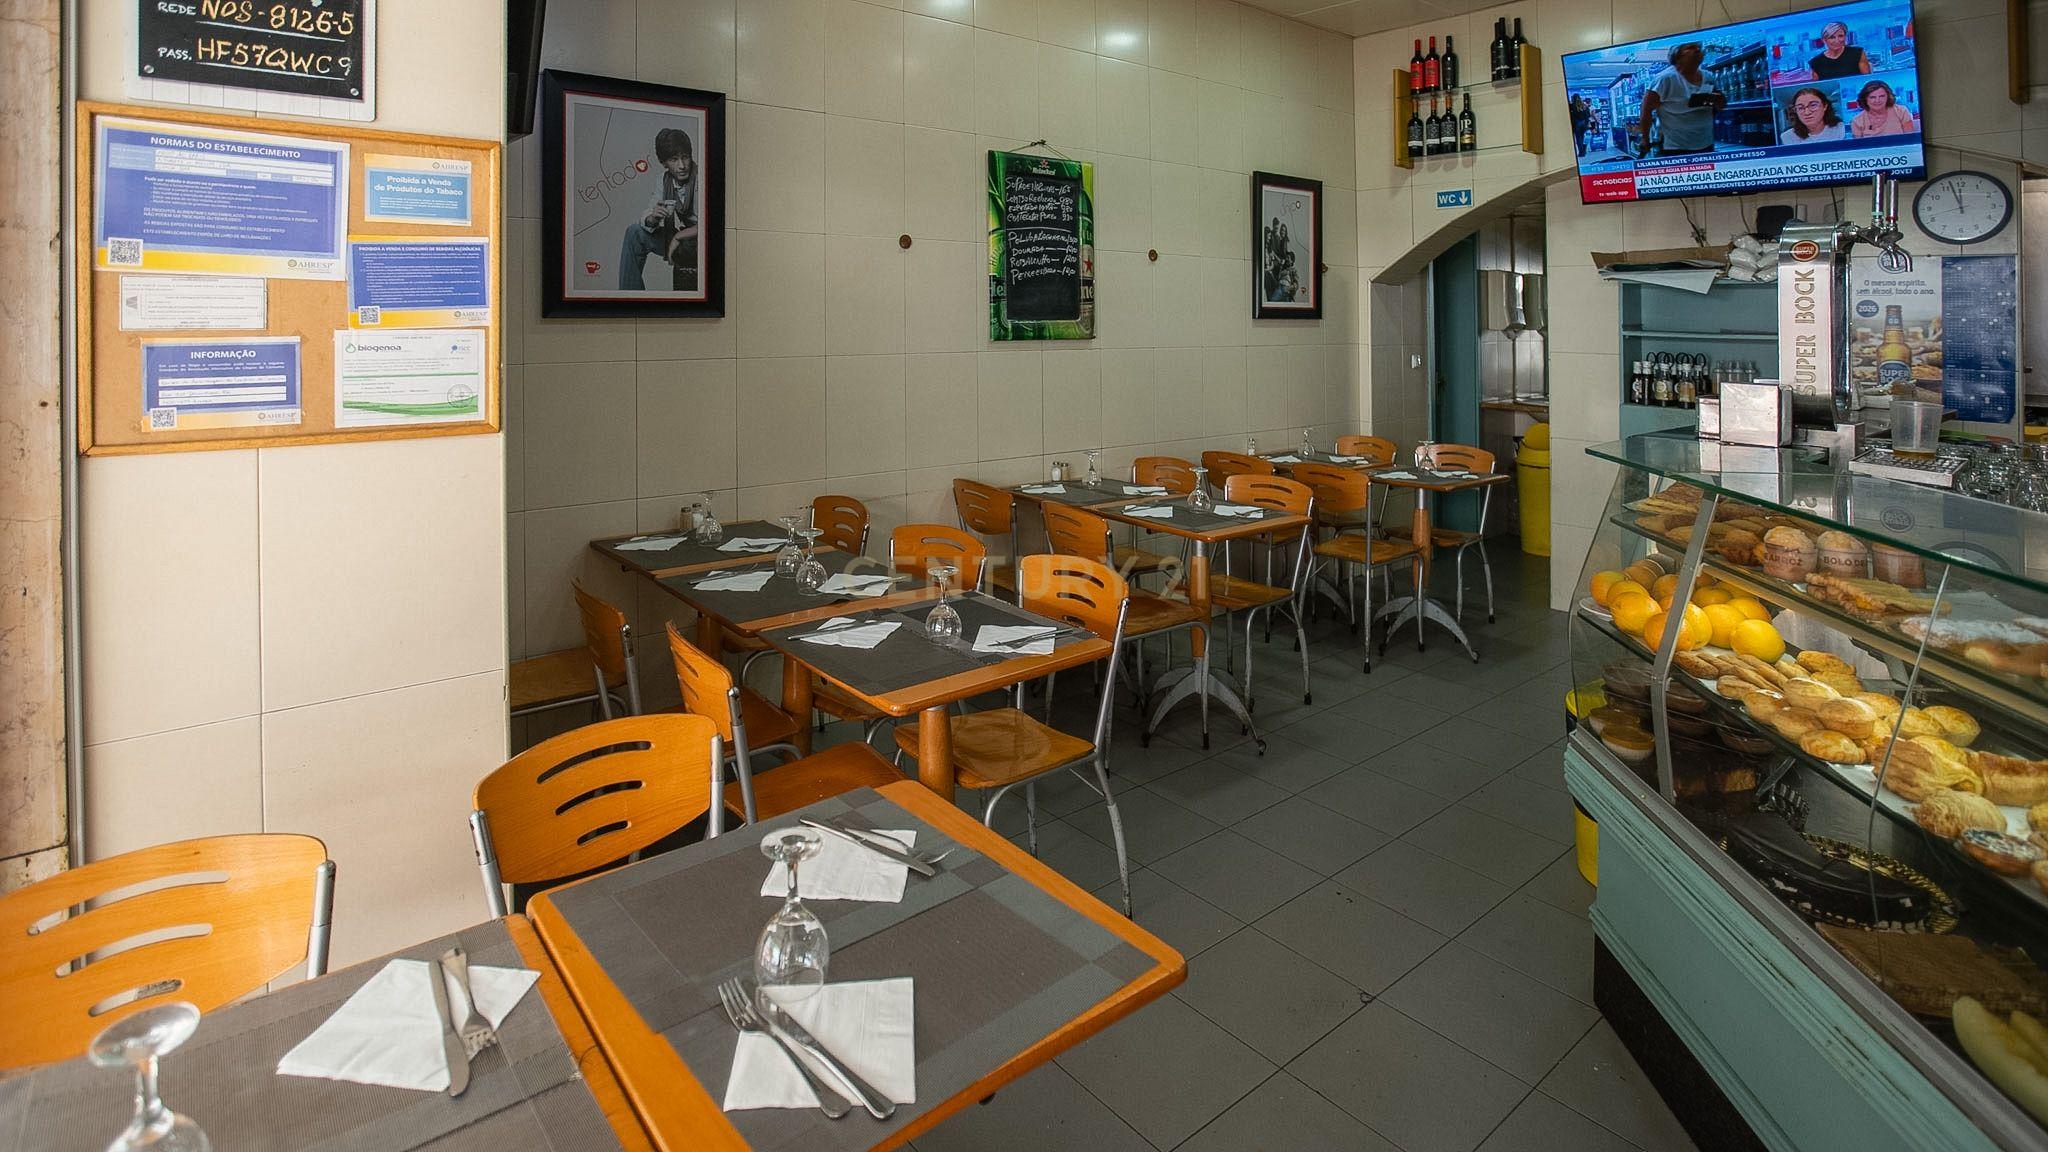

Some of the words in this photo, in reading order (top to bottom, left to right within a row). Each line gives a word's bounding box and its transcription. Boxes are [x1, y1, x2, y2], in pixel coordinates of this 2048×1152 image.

[158, 2, 196, 15] REDE
[158, 47, 192, 61] PASS.
[1460, 119, 1471, 132] JP
[150, 136, 195, 149] NORMAS
[197, 141, 212, 150] DO
[214, 143, 301, 159] ESTABELECIMENTO
[1637, 160, 1660, 168] LILIANA
[1661, 158, 1687, 166] VALENTE
[1691, 154, 1729, 163] JORNALISTA
[1730, 150, 1766, 160] EXPRESSO
[1651, 175, 1670, 186] NÃO
[1687, 172, 1712, 183] ÁGUA
[1713, 167, 1785, 181] ENGARRAFADA
[1785, 164, 1808, 174] NOS
[1810, 155, 1908, 173] SUPERMERCADOS
[386, 175, 420, 184] Proibida
[428, 178, 451, 187] Venda
[1660, 185, 1692, 193] GRATUITOS
[1709, 181, 1745, 190] RESIDENTES
[1810, 174, 1831, 182] DESTA
[1832, 170, 1877, 180] SEXTA-FEIRA
[386, 184, 422, 193] Produtos
[424, 186, 434, 194] do
[1438, 194, 1456, 204] WC
[297, 261, 333, 269] AHRESP
[1795, 269, 1816, 325] BOCK
[190, 349, 256, 360] INFORMAÇÃO
[358, 344, 401, 353] biogenoa
[1795, 334, 1816, 397] SUPER
[1880, 368, 1909, 377] SUPER
[1823, 556, 1853, 567] BOLO
[1854, 557, 1865, 567] DE
